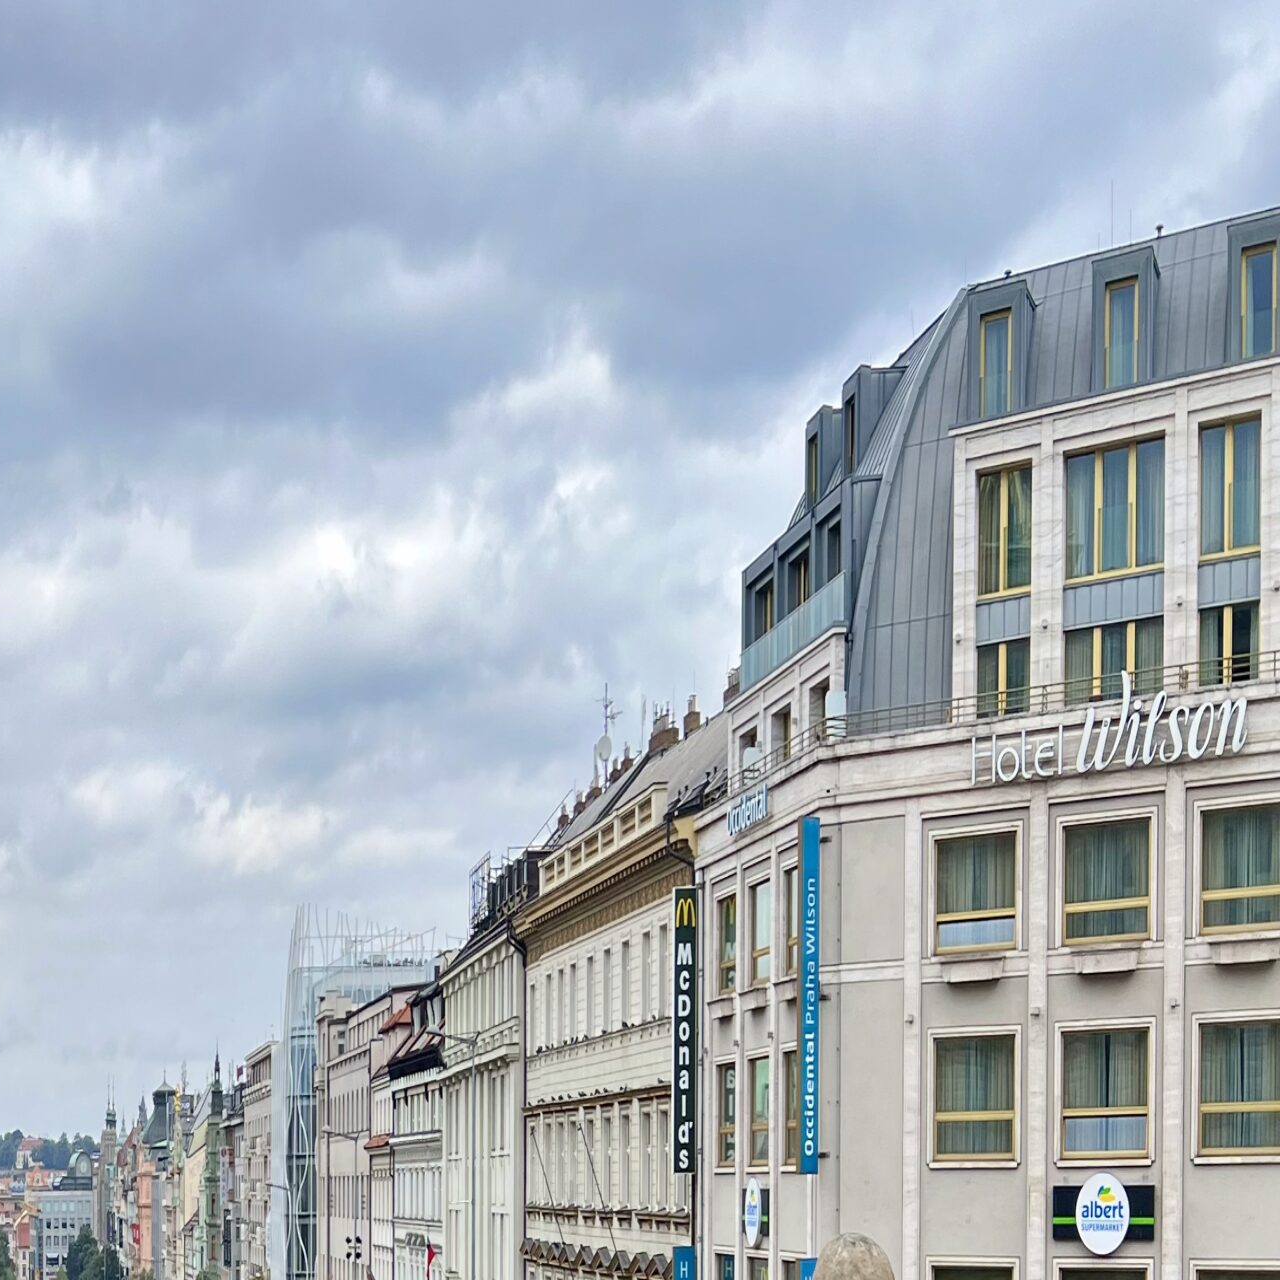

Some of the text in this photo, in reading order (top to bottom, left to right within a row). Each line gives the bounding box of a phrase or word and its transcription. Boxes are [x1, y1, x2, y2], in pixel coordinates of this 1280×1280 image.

[971, 670, 1249, 785] Hotel Wilson
[727, 784, 768, 837] Occidental
[676, 942, 694, 1169] McDonald's
[804, 877, 816, 1156] Occidental Praha Wilson
[1081, 1201, 1124, 1219] albert
[1081, 1224, 1124, 1232] SUPERMARKET
